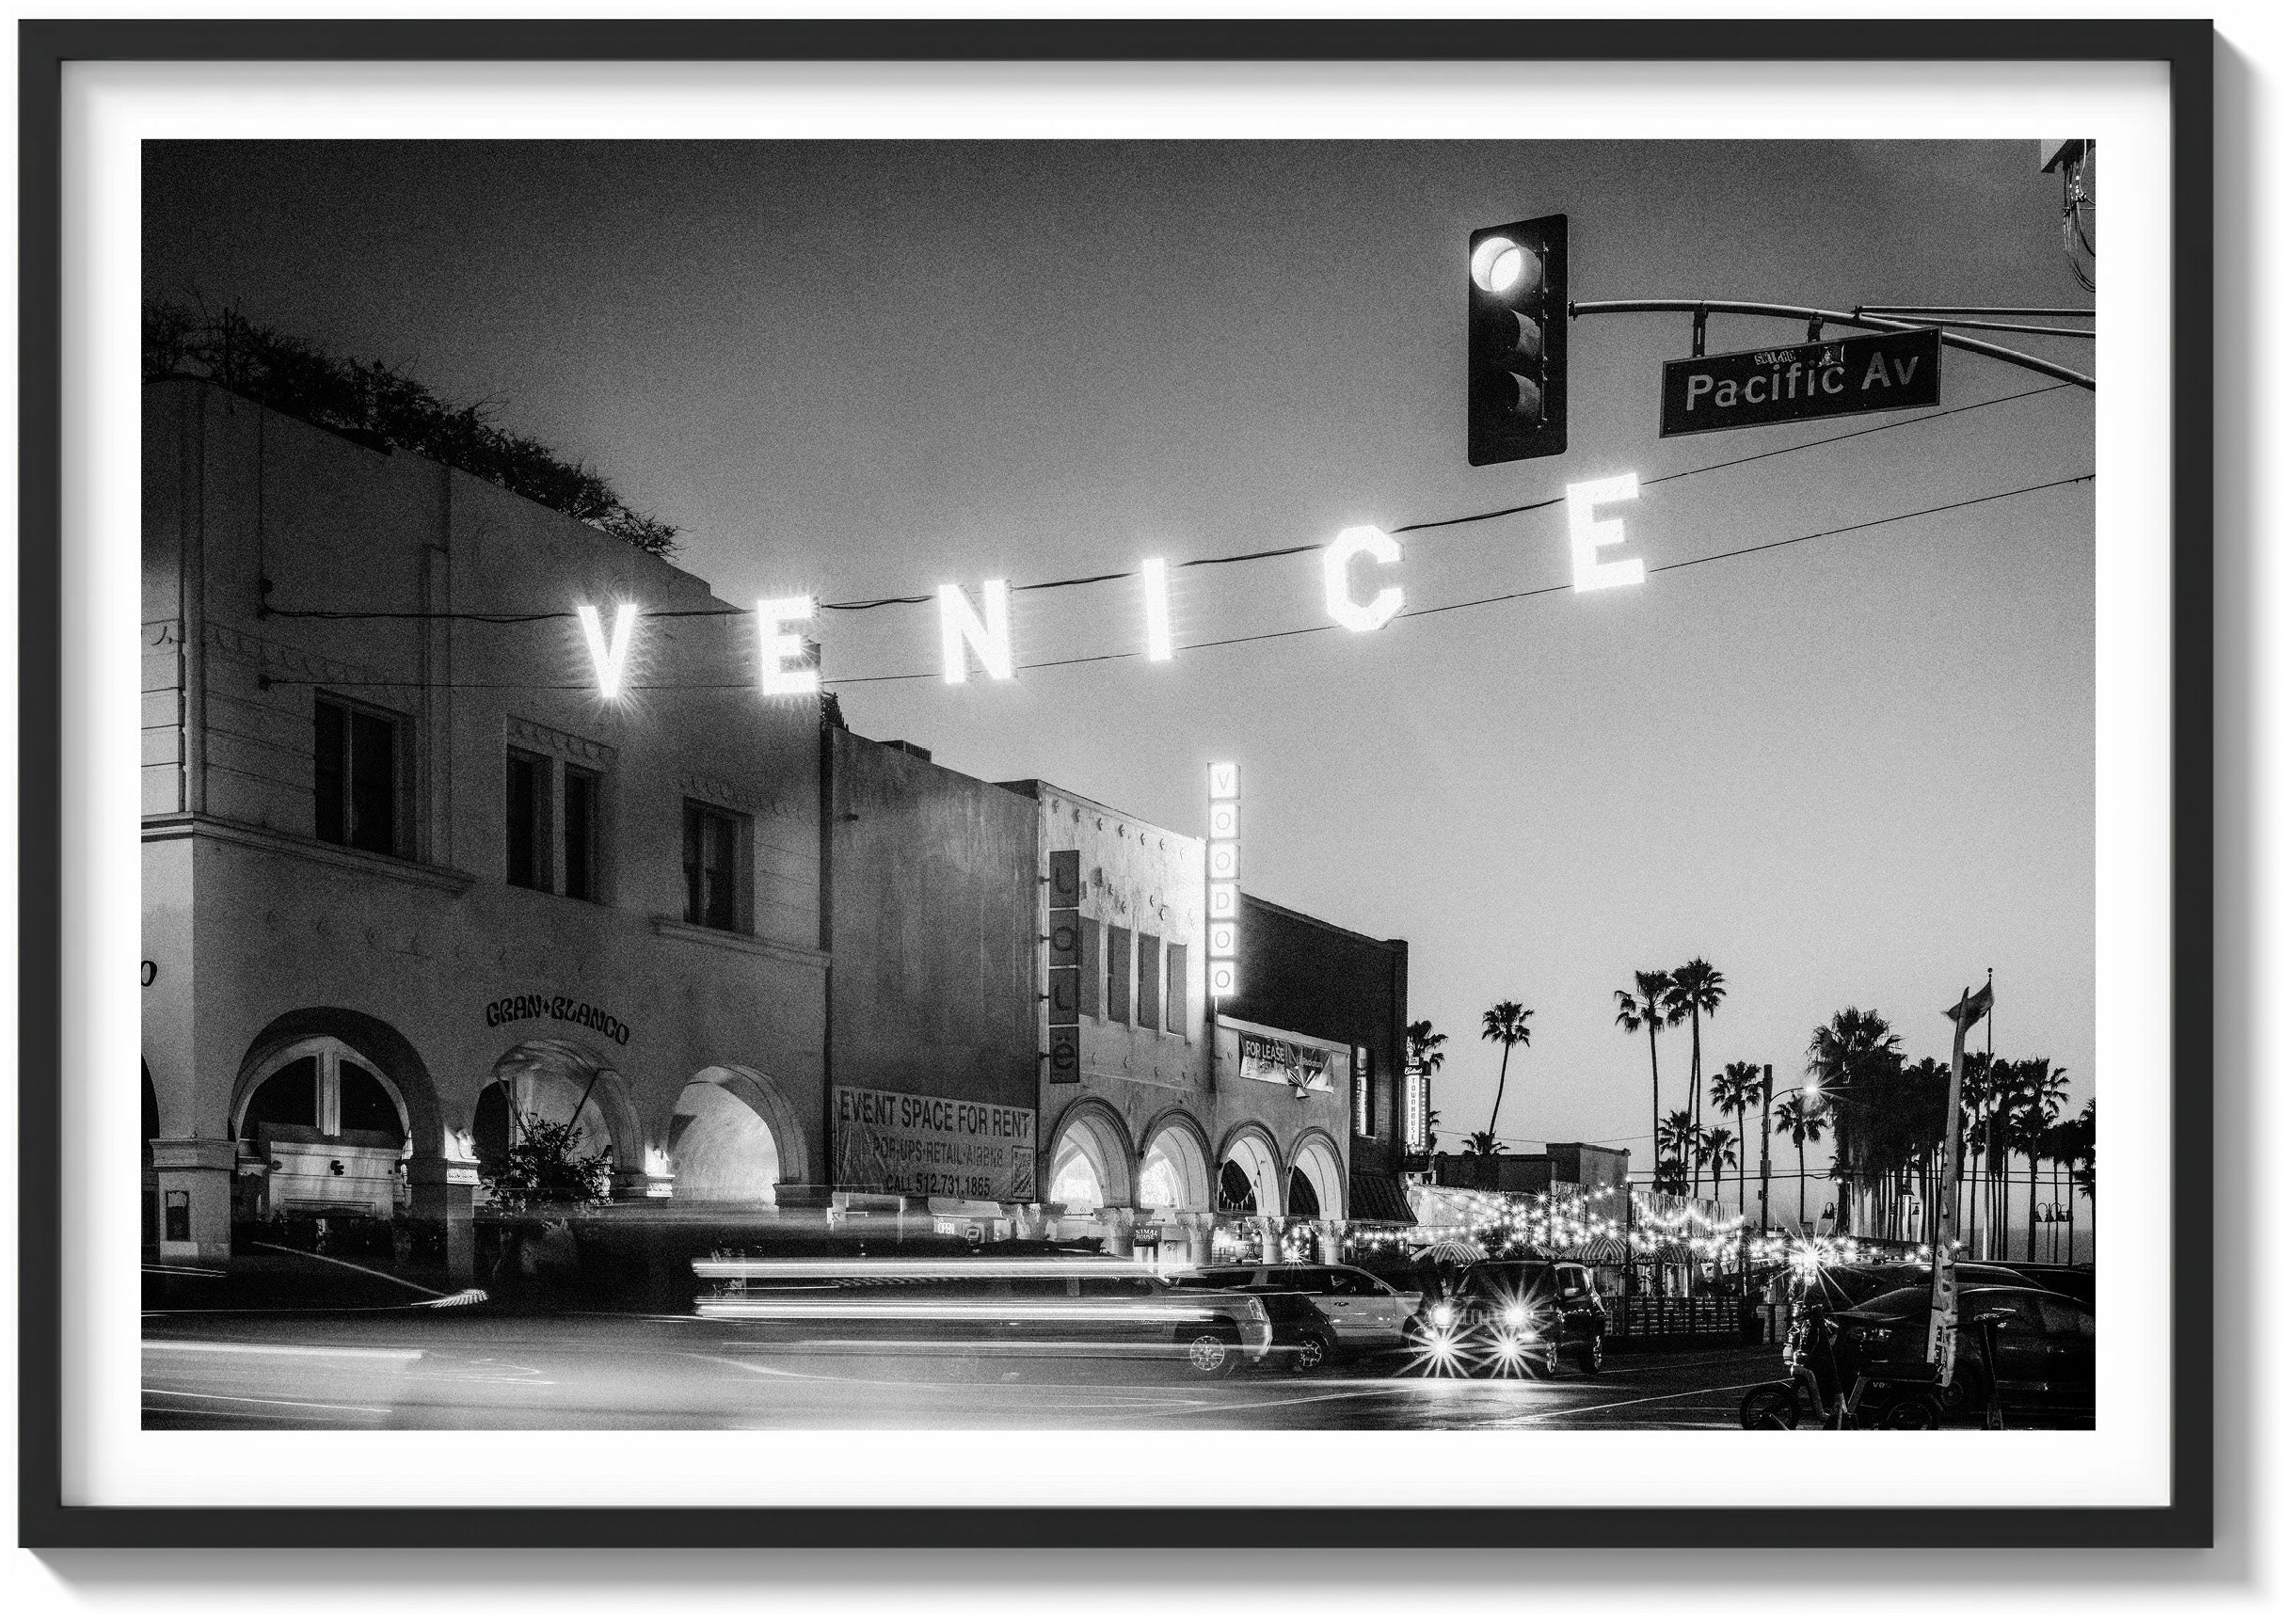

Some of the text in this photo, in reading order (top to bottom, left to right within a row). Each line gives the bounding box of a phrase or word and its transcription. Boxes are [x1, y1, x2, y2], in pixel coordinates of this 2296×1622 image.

[1686, 351, 1919, 411] Pacific Av
[577, 474, 1647, 699] VENICE
[1215, 771, 1232, 989] VOODOO
[486, 994, 630, 1046] GRAN BLANCO
[1245, 1040, 1261, 1059] FOR
[1262, 1044, 1285, 1062] LEASE
[840, 1089, 1030, 1138] EVENT SPACE FOR RENT
[886, 1174, 914, 1192] CALL
